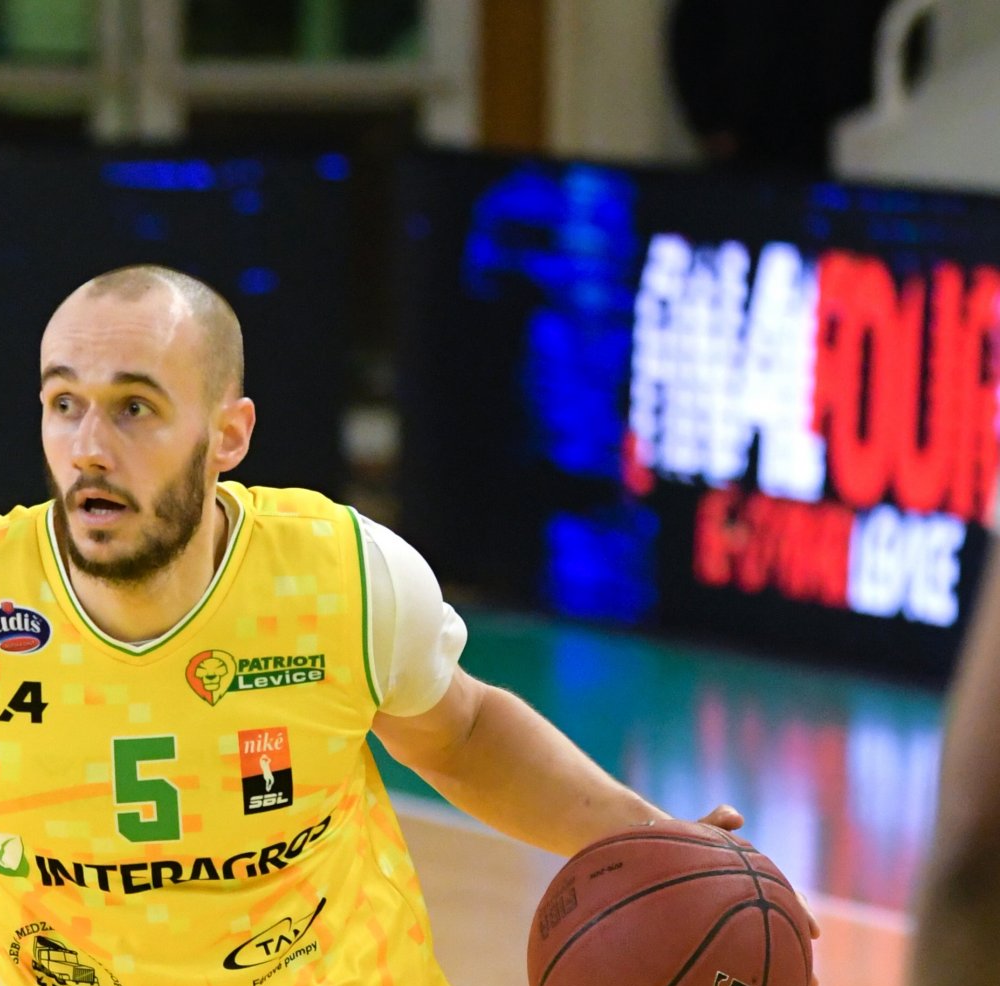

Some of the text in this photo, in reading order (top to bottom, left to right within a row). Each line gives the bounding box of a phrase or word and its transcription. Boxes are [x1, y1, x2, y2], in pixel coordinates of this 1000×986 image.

[238, 654, 326, 673] PATRIOTI
[238, 670, 322, 690] Levice
[243, 732, 284, 755] niké
[112, 735, 182, 843] 5
[248, 791, 289, 810] SBL
[284, 940, 318, 968] pumpy
